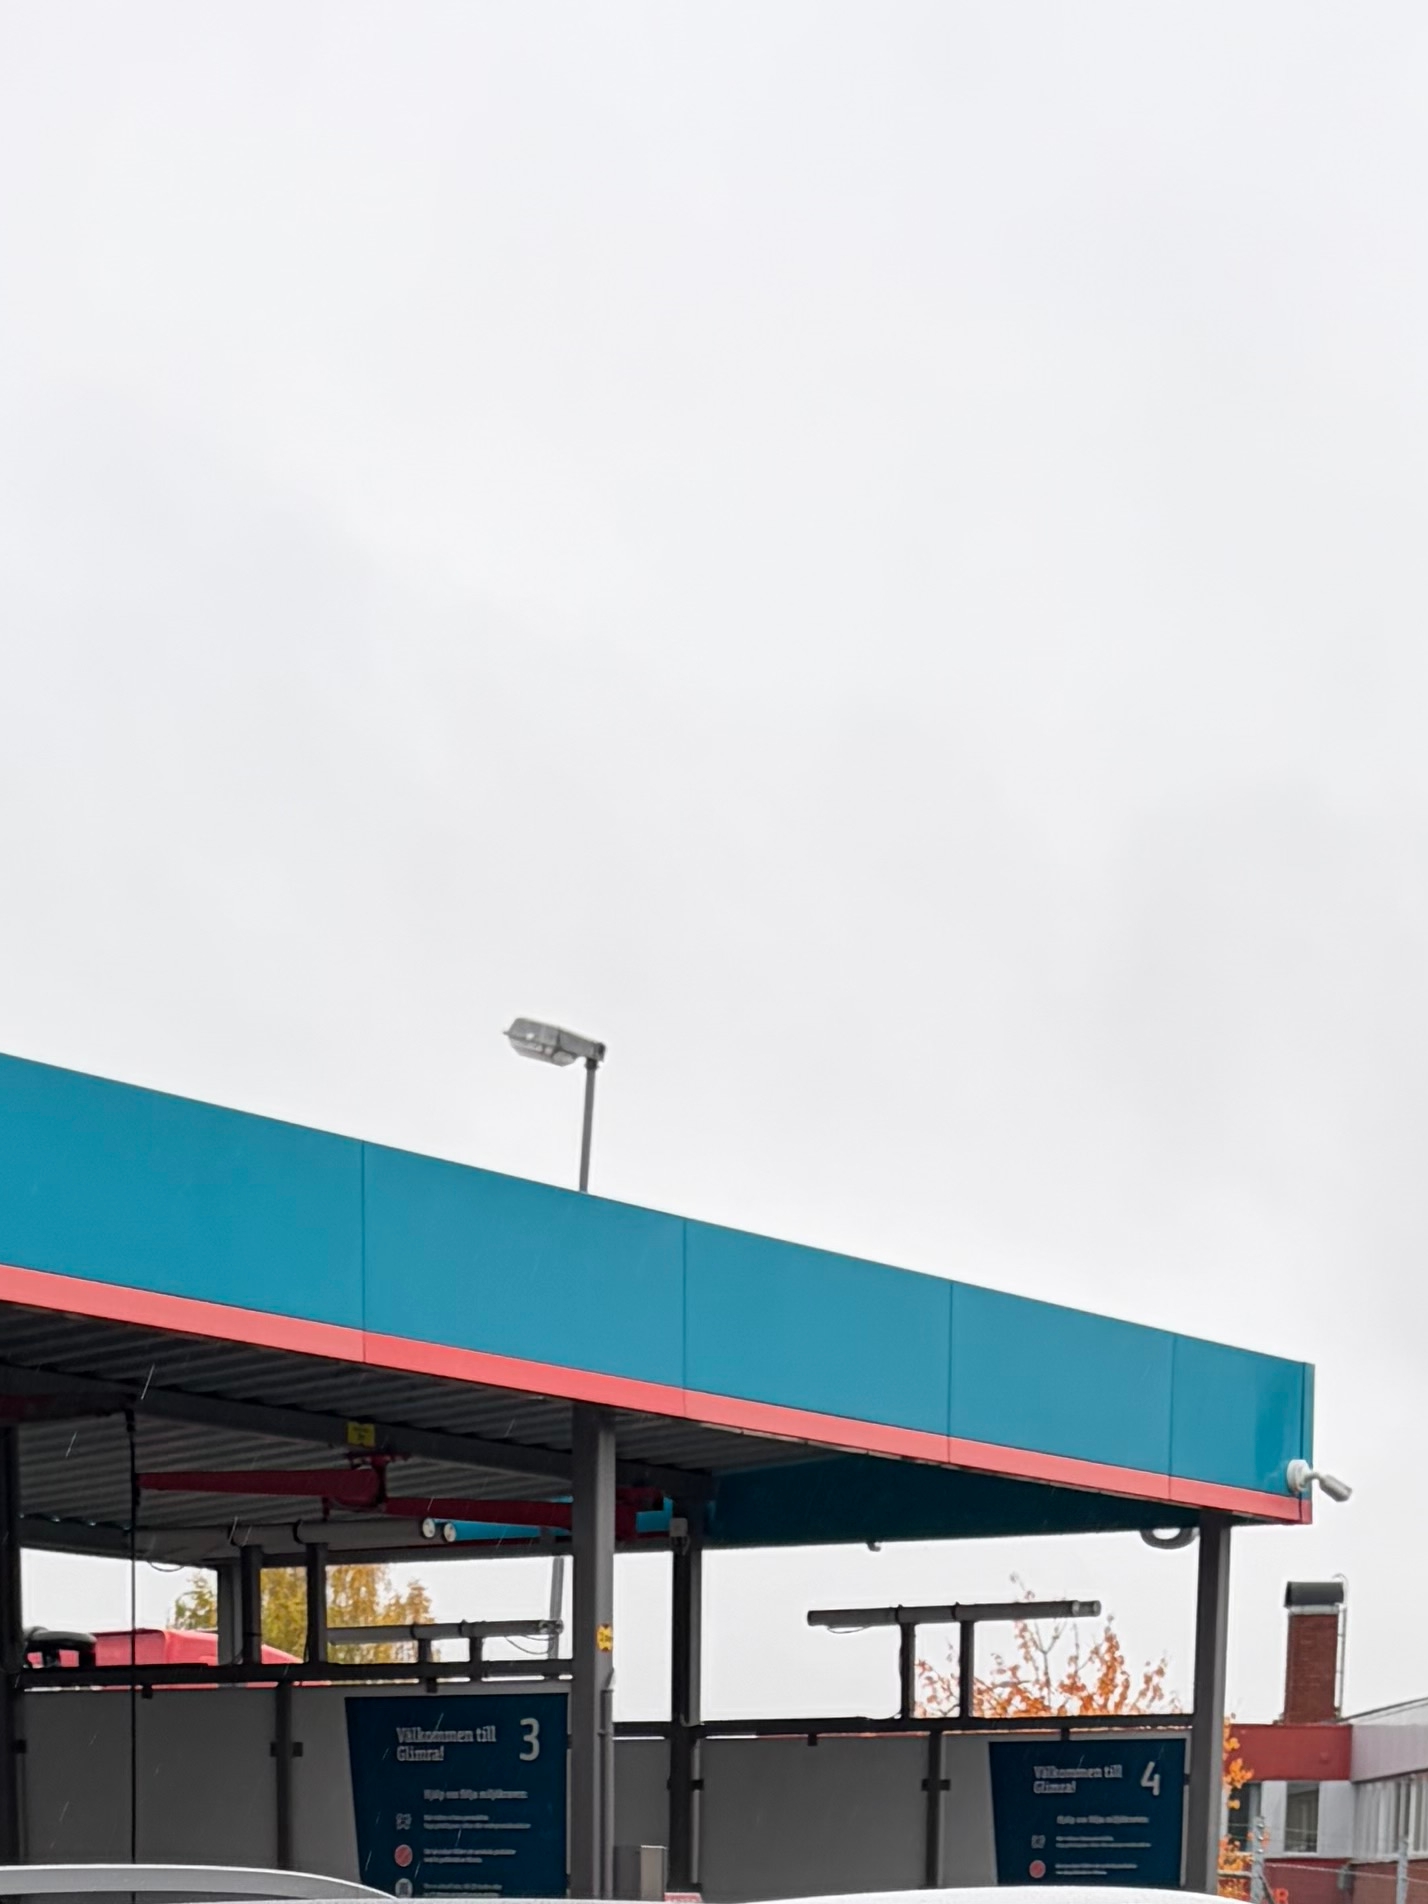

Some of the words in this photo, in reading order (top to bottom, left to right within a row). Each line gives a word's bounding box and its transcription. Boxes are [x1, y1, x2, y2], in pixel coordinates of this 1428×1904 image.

[476, 1725, 497, 1743] till
[519, 1717, 540, 1762] 3
[1140, 1761, 1161, 1796] 4
